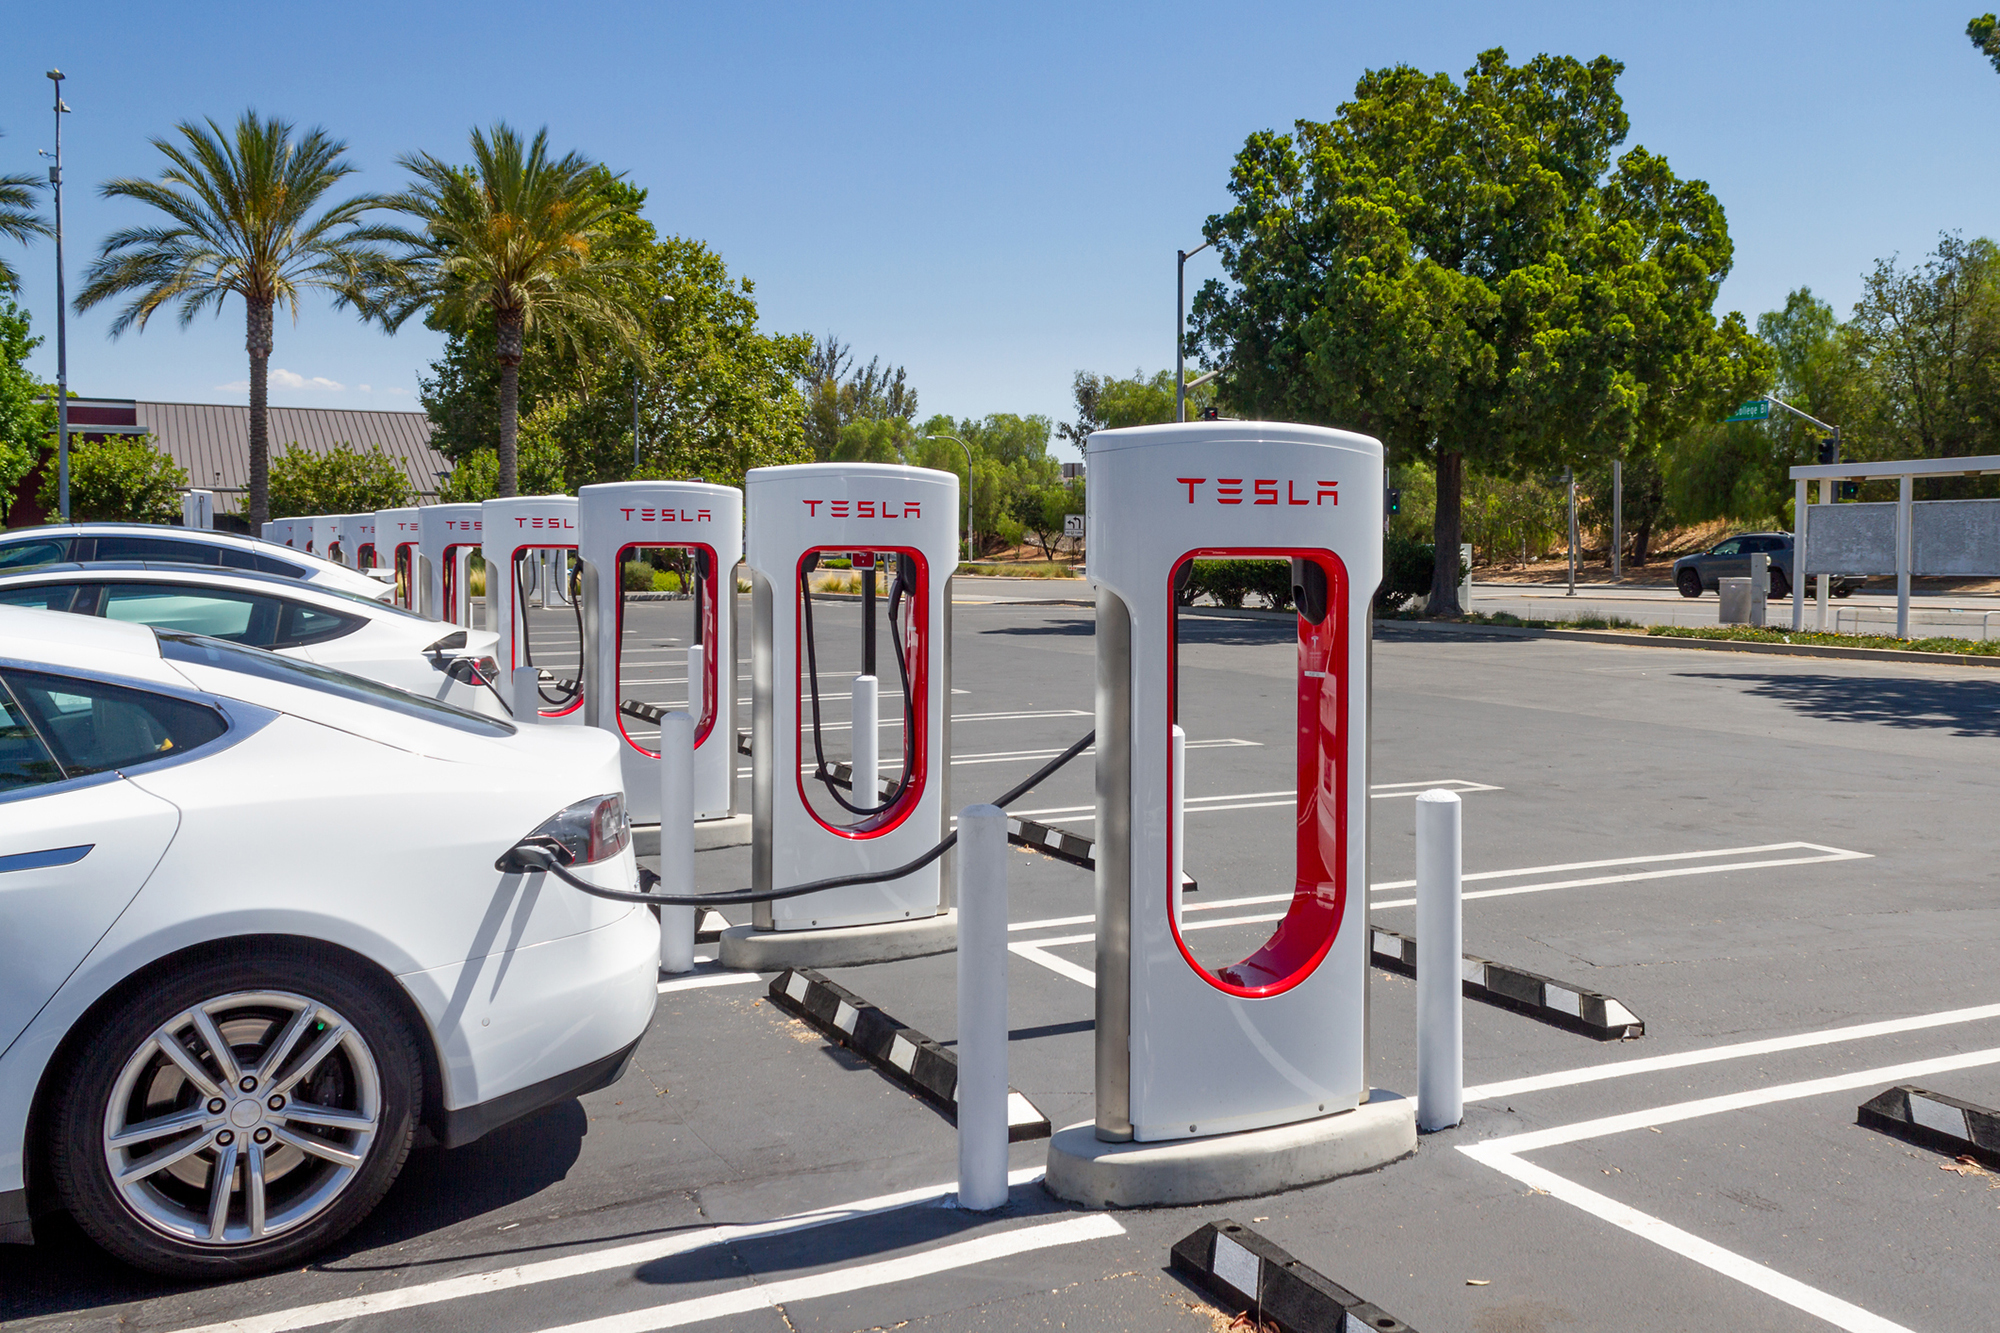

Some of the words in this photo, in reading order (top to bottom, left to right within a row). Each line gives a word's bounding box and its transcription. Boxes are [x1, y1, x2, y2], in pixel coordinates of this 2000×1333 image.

[1176, 477, 1338, 506] TESLA
[620, 508, 711, 522] TESLA
[803, 500, 921, 519] TESLA
[445, 521, 482, 531] TES
[514, 517, 574, 529] TESL
